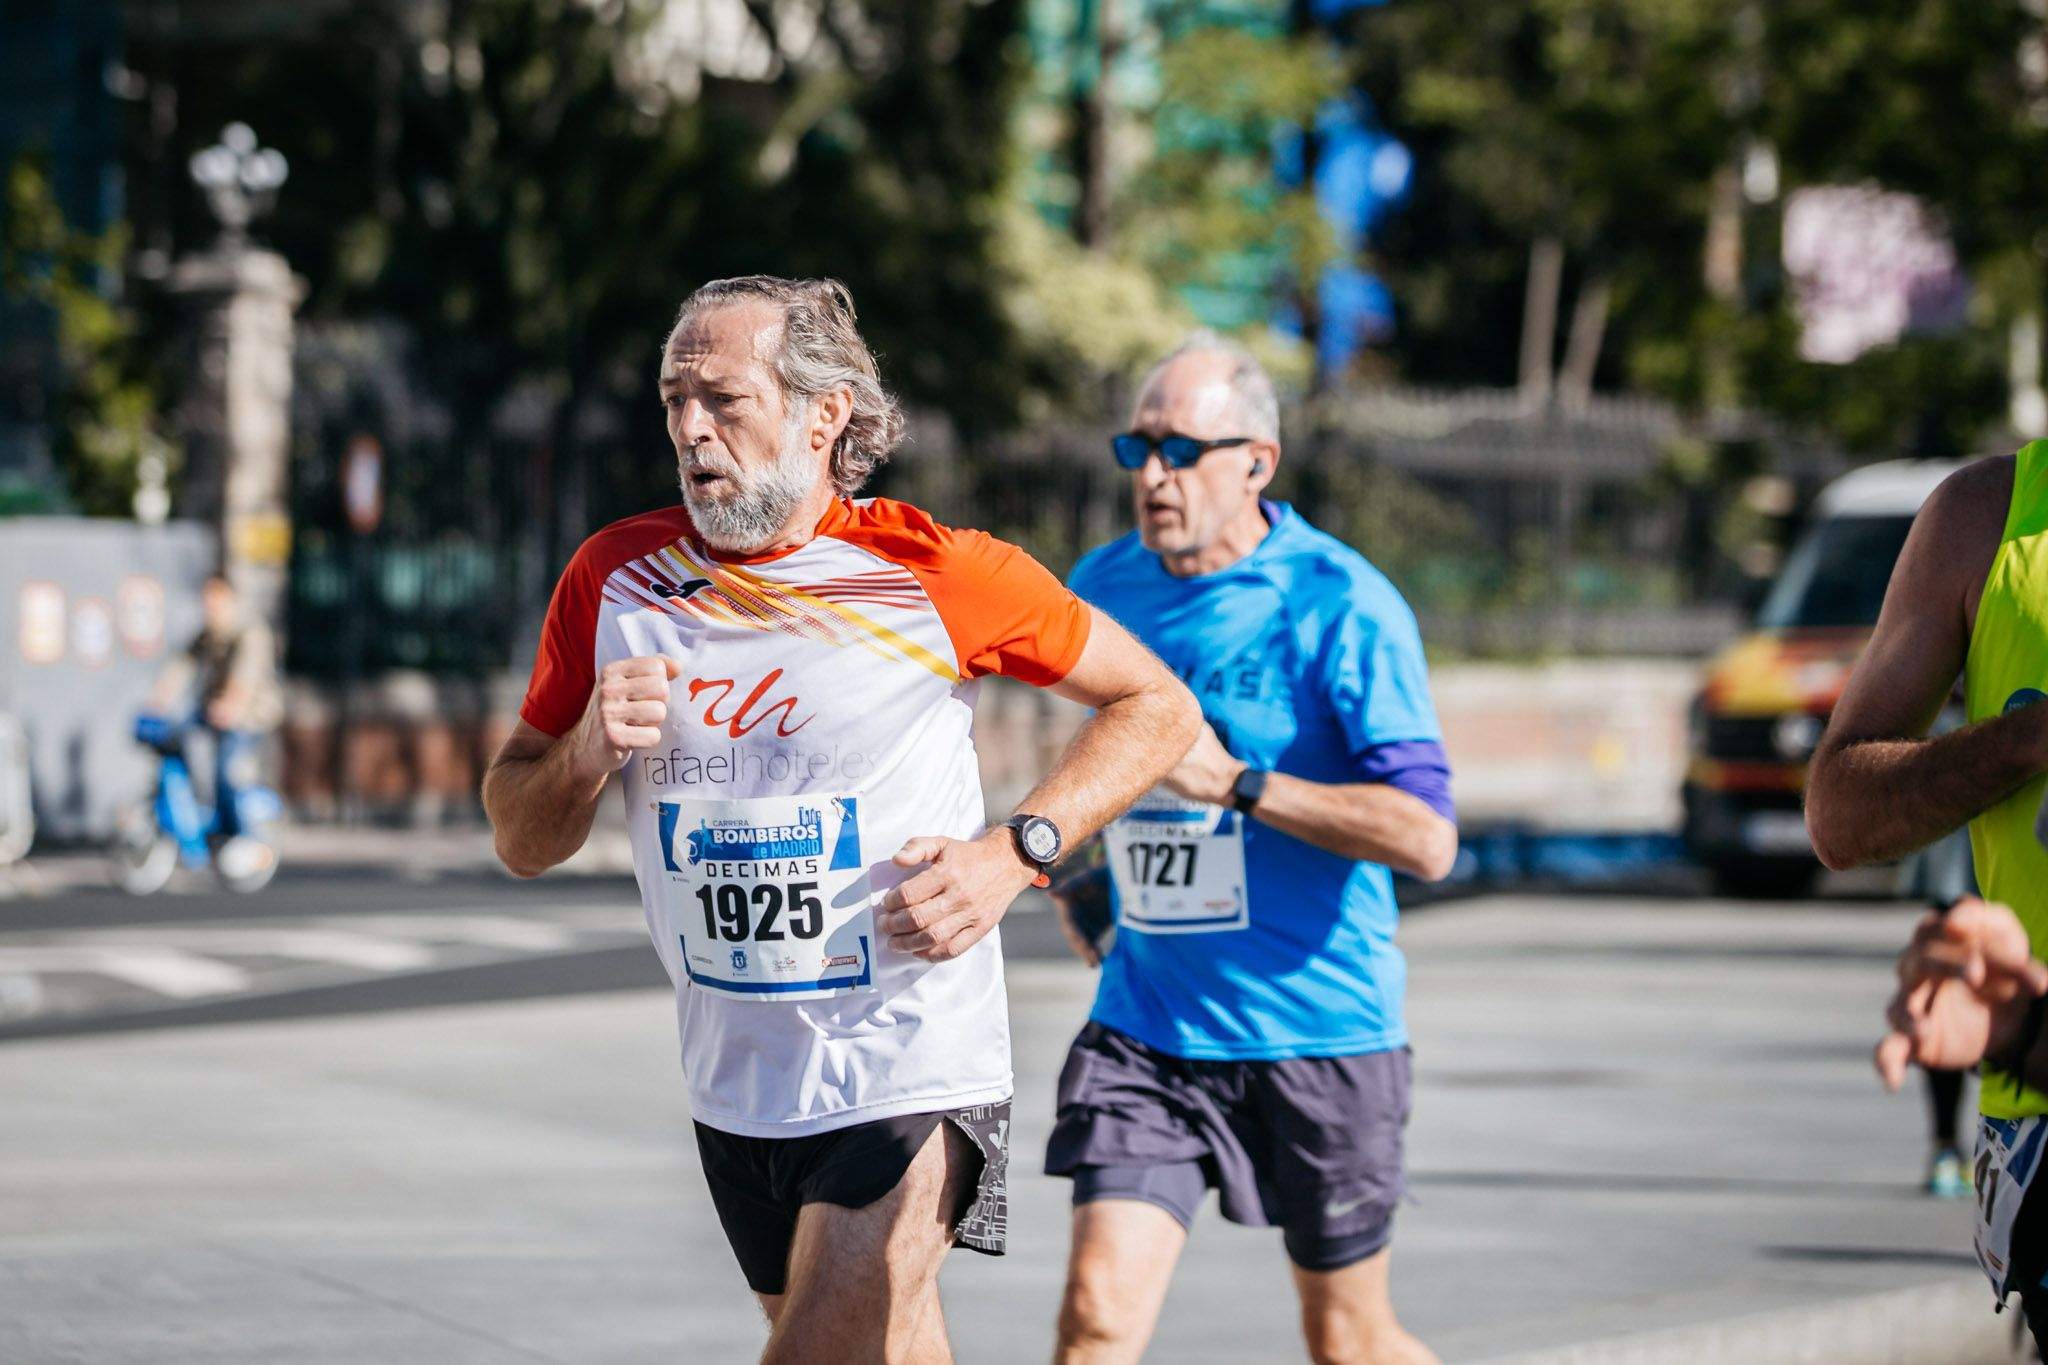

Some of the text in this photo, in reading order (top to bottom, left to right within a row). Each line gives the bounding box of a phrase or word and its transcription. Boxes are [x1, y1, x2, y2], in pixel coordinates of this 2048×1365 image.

[713, 819, 749, 828] CARRERA
[713, 824, 819, 844] BOMBEROS
[753, 840, 820, 858] de MADRID
[706, 859, 818, 878] DECIMAS
[695, 881, 824, 943] 1925
